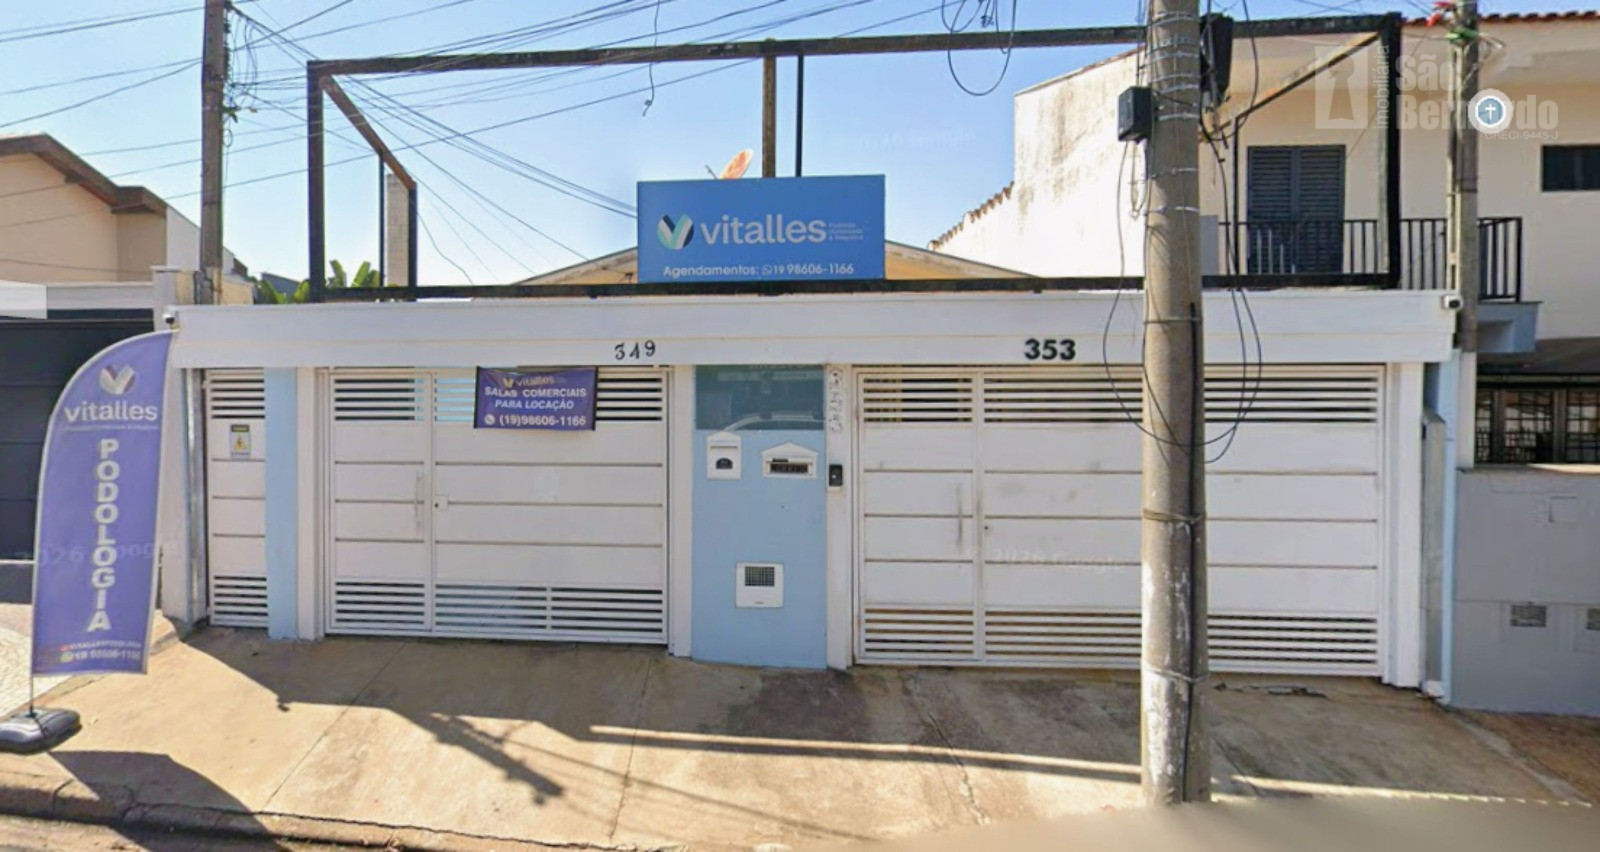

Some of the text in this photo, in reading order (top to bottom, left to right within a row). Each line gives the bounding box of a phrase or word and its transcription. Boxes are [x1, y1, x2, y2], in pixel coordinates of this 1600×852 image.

[700, 213, 827, 245] vitalles
[663, 263, 855, 278] Agendamentos: 19 98606-1166
[614, 340, 656, 360] 349
[1024, 338, 1076, 361] 353
[484, 386, 588, 398] SALAS COMERCIAIS
[64, 401, 158, 422] vitalles
[494, 398, 575, 411] PARA LOCAÇÃO
[499, 414, 587, 427] (19)98606-1166
[87, 438, 120, 633] PODOLOGIA
